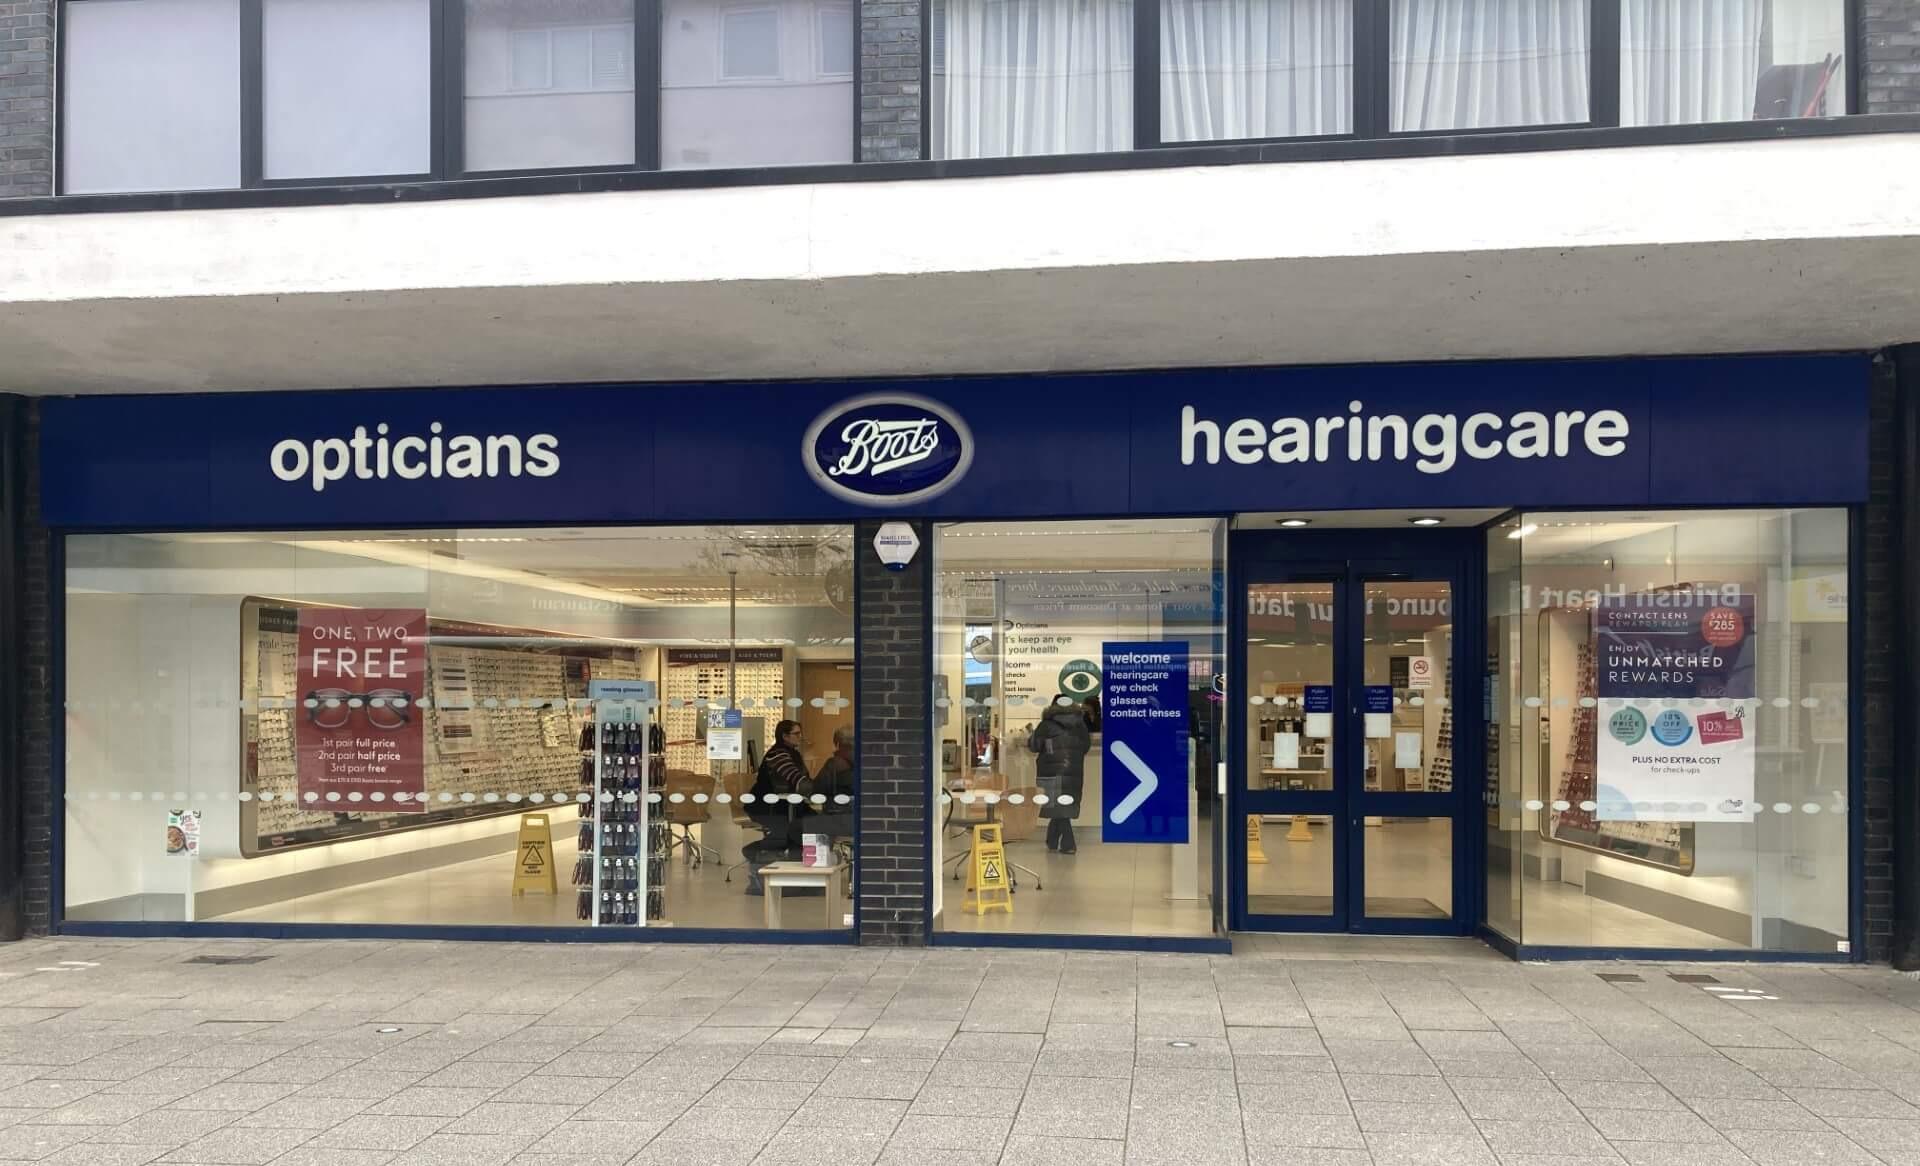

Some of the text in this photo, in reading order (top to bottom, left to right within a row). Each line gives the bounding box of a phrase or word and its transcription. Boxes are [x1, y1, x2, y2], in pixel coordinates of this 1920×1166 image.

[1181, 400, 1630, 474] hearingcare
[828, 418, 939, 477] Boots
[270, 422, 561, 492] opticians
[1608, 612, 1689, 620] CONTACT LENS
[1710, 612, 1735, 620] SAVE
[312, 625, 356, 641] ONE,
[1018, 635, 1041, 644] keep
[1056, 635, 1073, 645] eye
[1008, 645, 1059, 655] your health
[1608, 644, 1641, 654] ENJOY
[312, 646, 408, 679] FREE
[1109, 650, 1171, 664] welcome
[1608, 655, 1724, 668] UNMATCHED
[1109, 670, 1170, 681] hearingcare
[1608, 671, 1695, 683] REWARDS
[1109, 682, 1159, 694] eye check
[1109, 695, 1148, 707] glasses
[1109, 707, 1182, 718] contact lenses
[322, 737, 396, 751] 1st pair full price
[318, 749, 401, 763] 2nd pair half price
[1632, 756, 1721, 765] PLUS NO EXTRA COST
[331, 763, 346, 773] 3rd
[347, 764, 366, 776] pair
[1651, 766, 1701, 775] for check-ups
